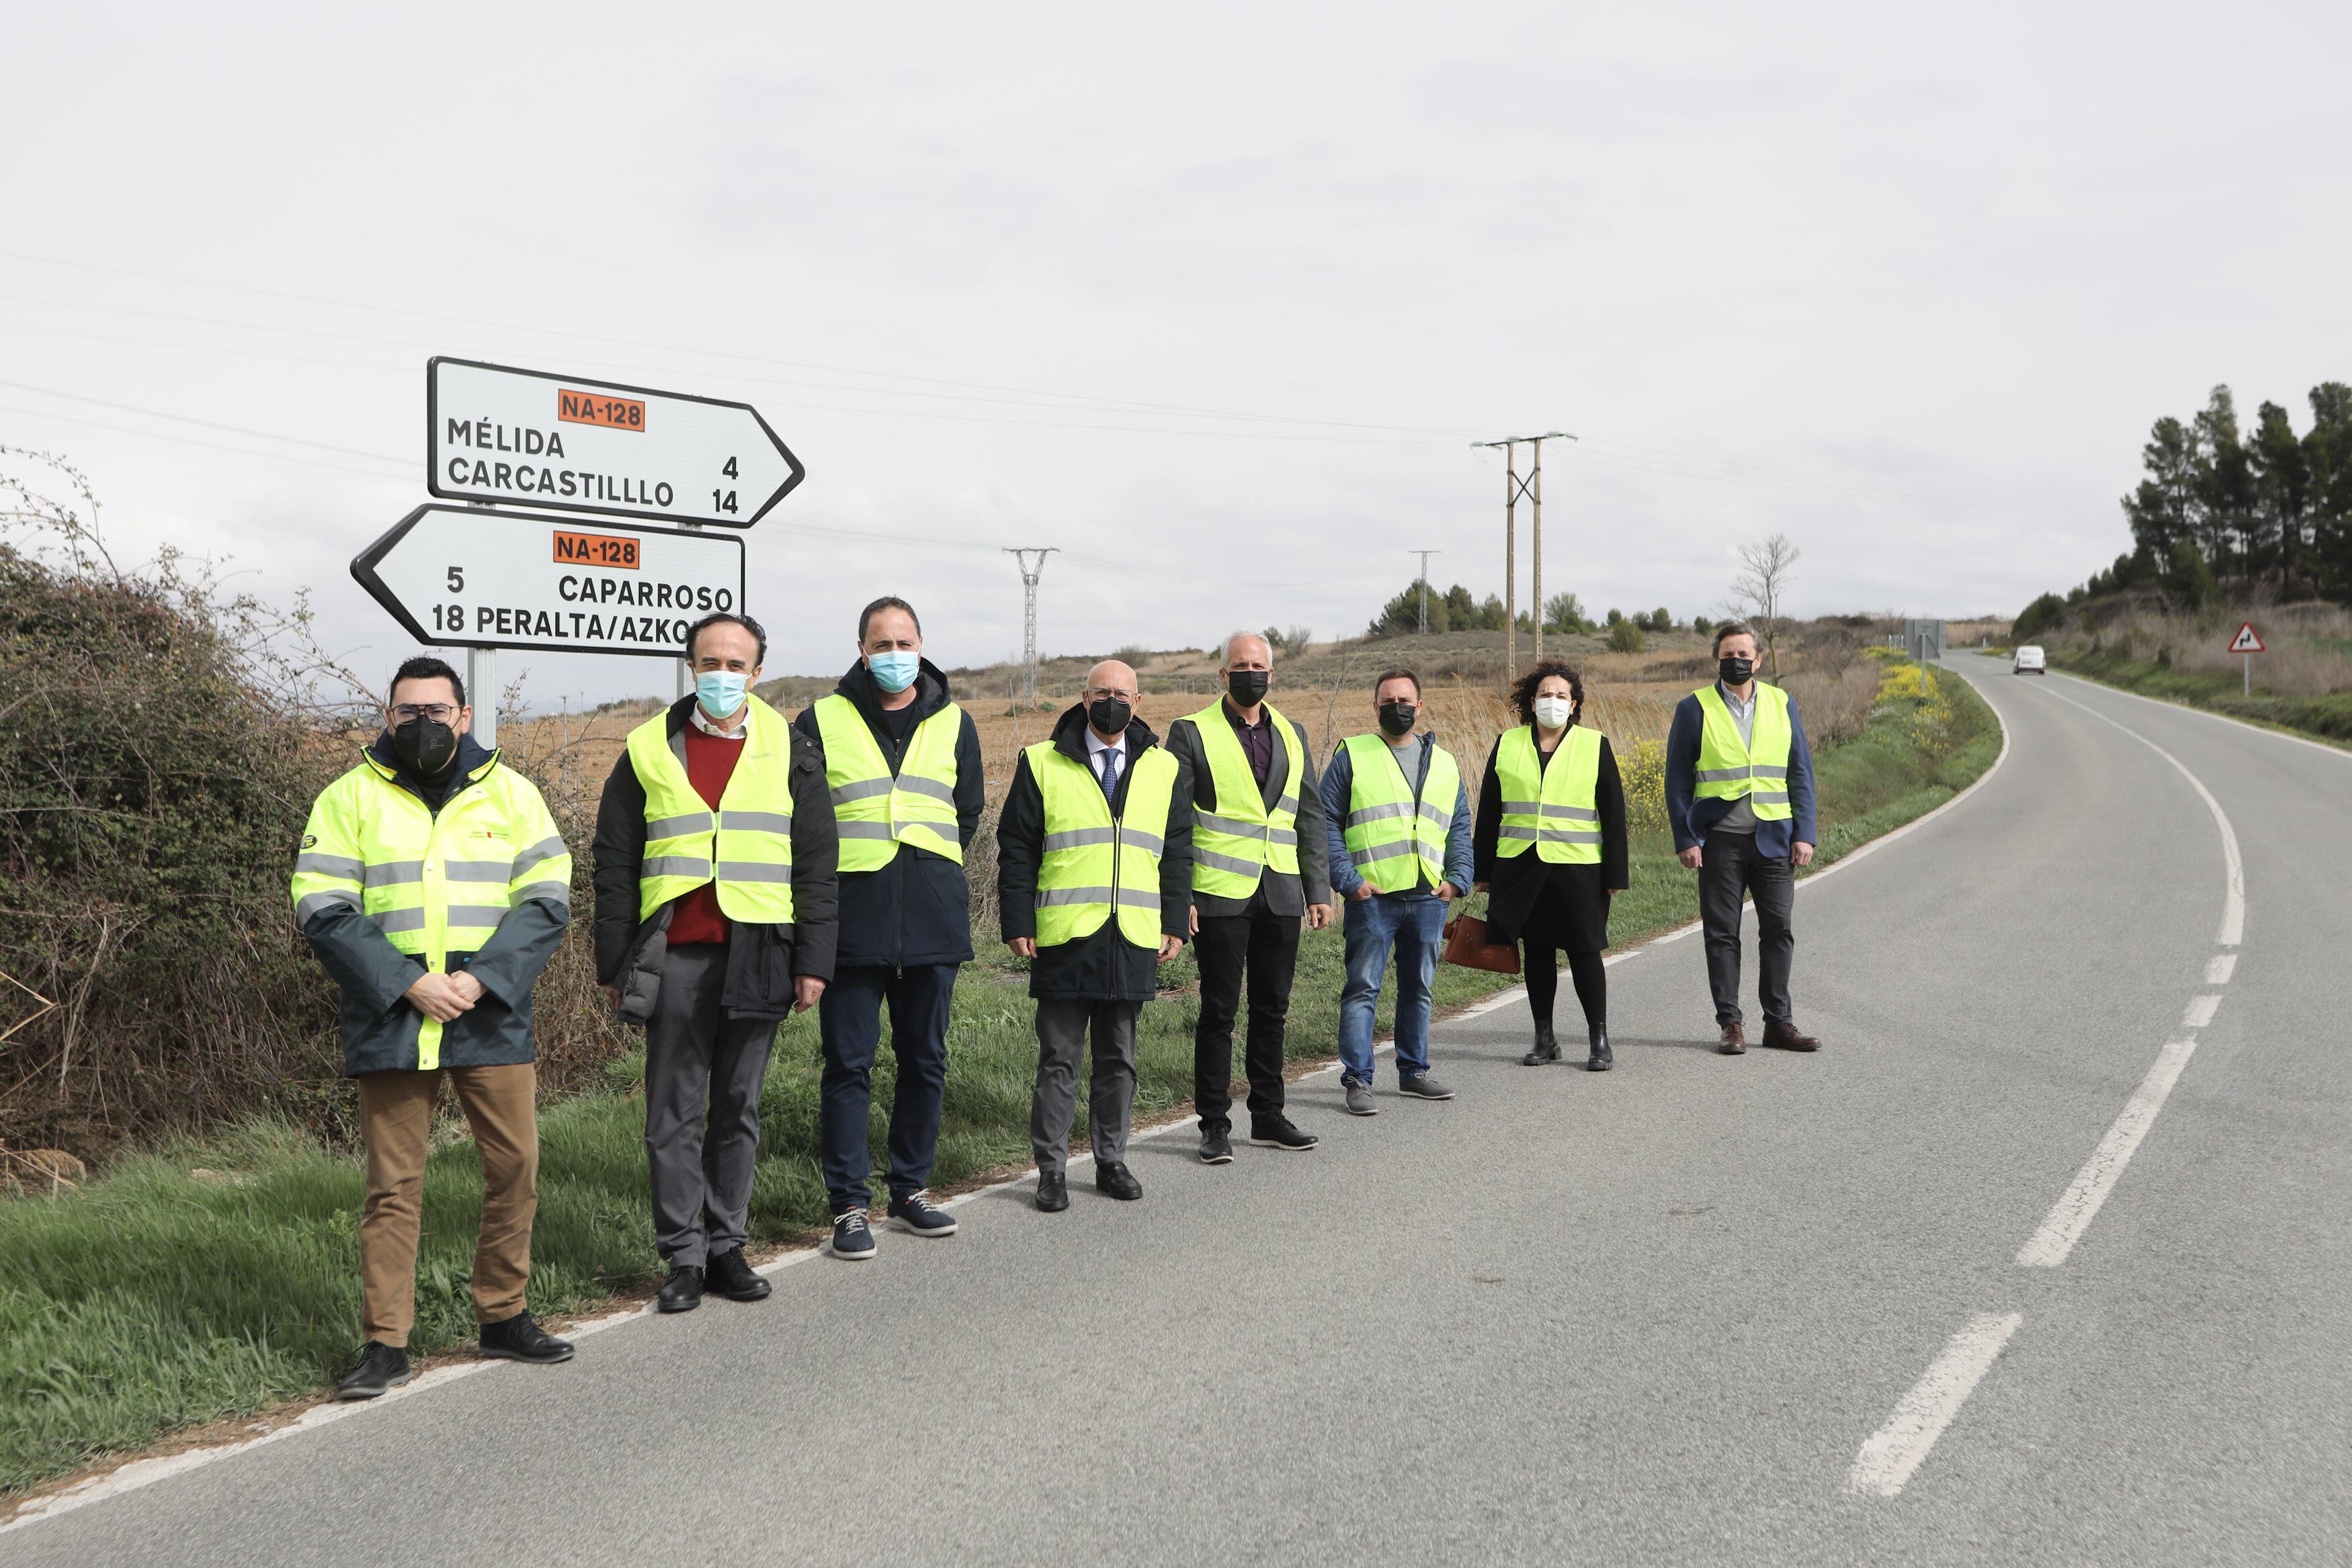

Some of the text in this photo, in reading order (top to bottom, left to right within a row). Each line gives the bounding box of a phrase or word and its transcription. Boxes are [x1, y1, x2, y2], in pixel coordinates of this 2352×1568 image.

[562, 395, 641, 427] NA-128
[448, 416, 739, 481] MÉLIDA 4
[448, 458, 739, 515] CARCASTILLLO 14
[557, 536, 636, 564] NA-128
[447, 566, 733, 613] 5 CAPARROSO
[433, 604, 695, 645] 18 PERALTA/AZKO
